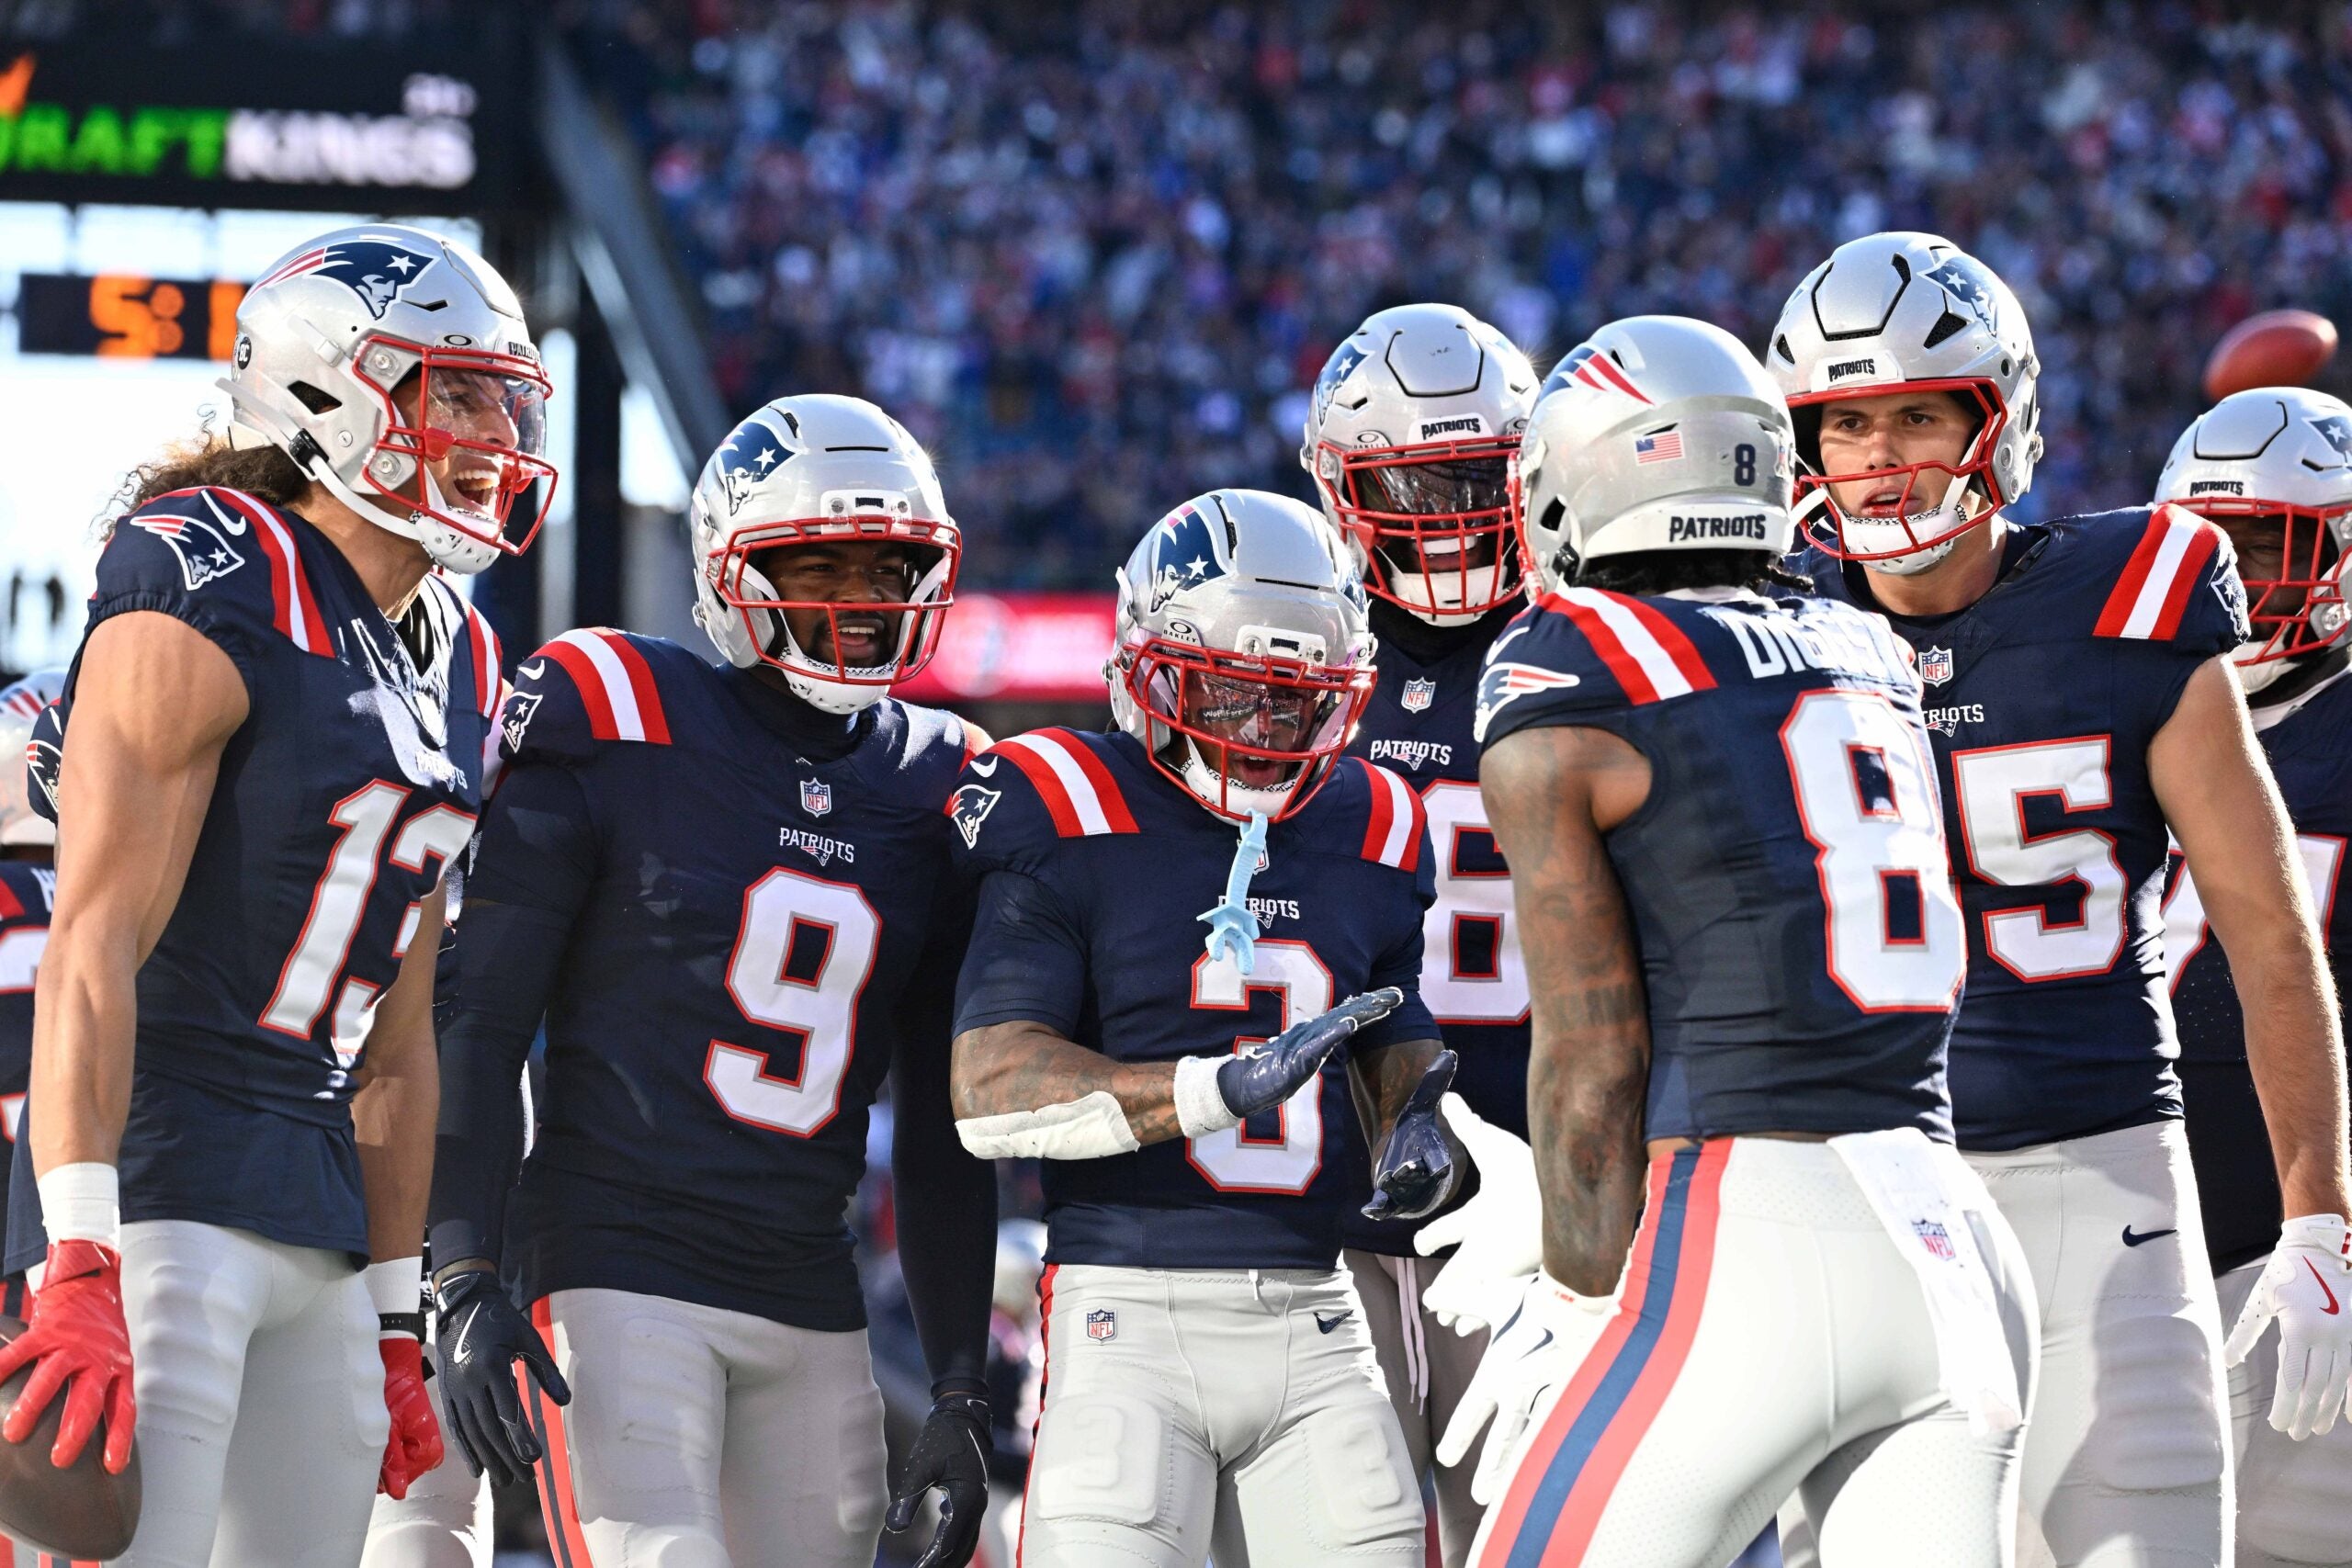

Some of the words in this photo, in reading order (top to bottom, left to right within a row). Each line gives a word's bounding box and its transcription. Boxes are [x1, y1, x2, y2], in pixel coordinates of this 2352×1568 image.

[0, 106, 476, 188] RAFTKINGS
[1828, 358, 1875, 382] PATRIOTS
[1421, 418, 1481, 440] PATRIOTS
[1734, 444, 1756, 487] 8
[2189, 481, 2244, 497] PATRIOTS
[1669, 513, 1766, 542] PATRIOTS
[1163, 629, 1196, 642] OAKLEY
[1926, 664, 1948, 679] NFL
[1408, 692, 1427, 705] NFL
[1370, 739, 1452, 765] PATRIOTS
[808, 794, 828, 809] NFL
[779, 828, 854, 863] PATRIOTS
[1780, 688, 1968, 1014] 8
[1950, 734, 2129, 984] 5
[1421, 779, 1531, 1026] 6
[703, 865, 882, 1139] 9
[1185, 938, 1334, 1196] 3
[1091, 1323, 1113, 1337] NFL
